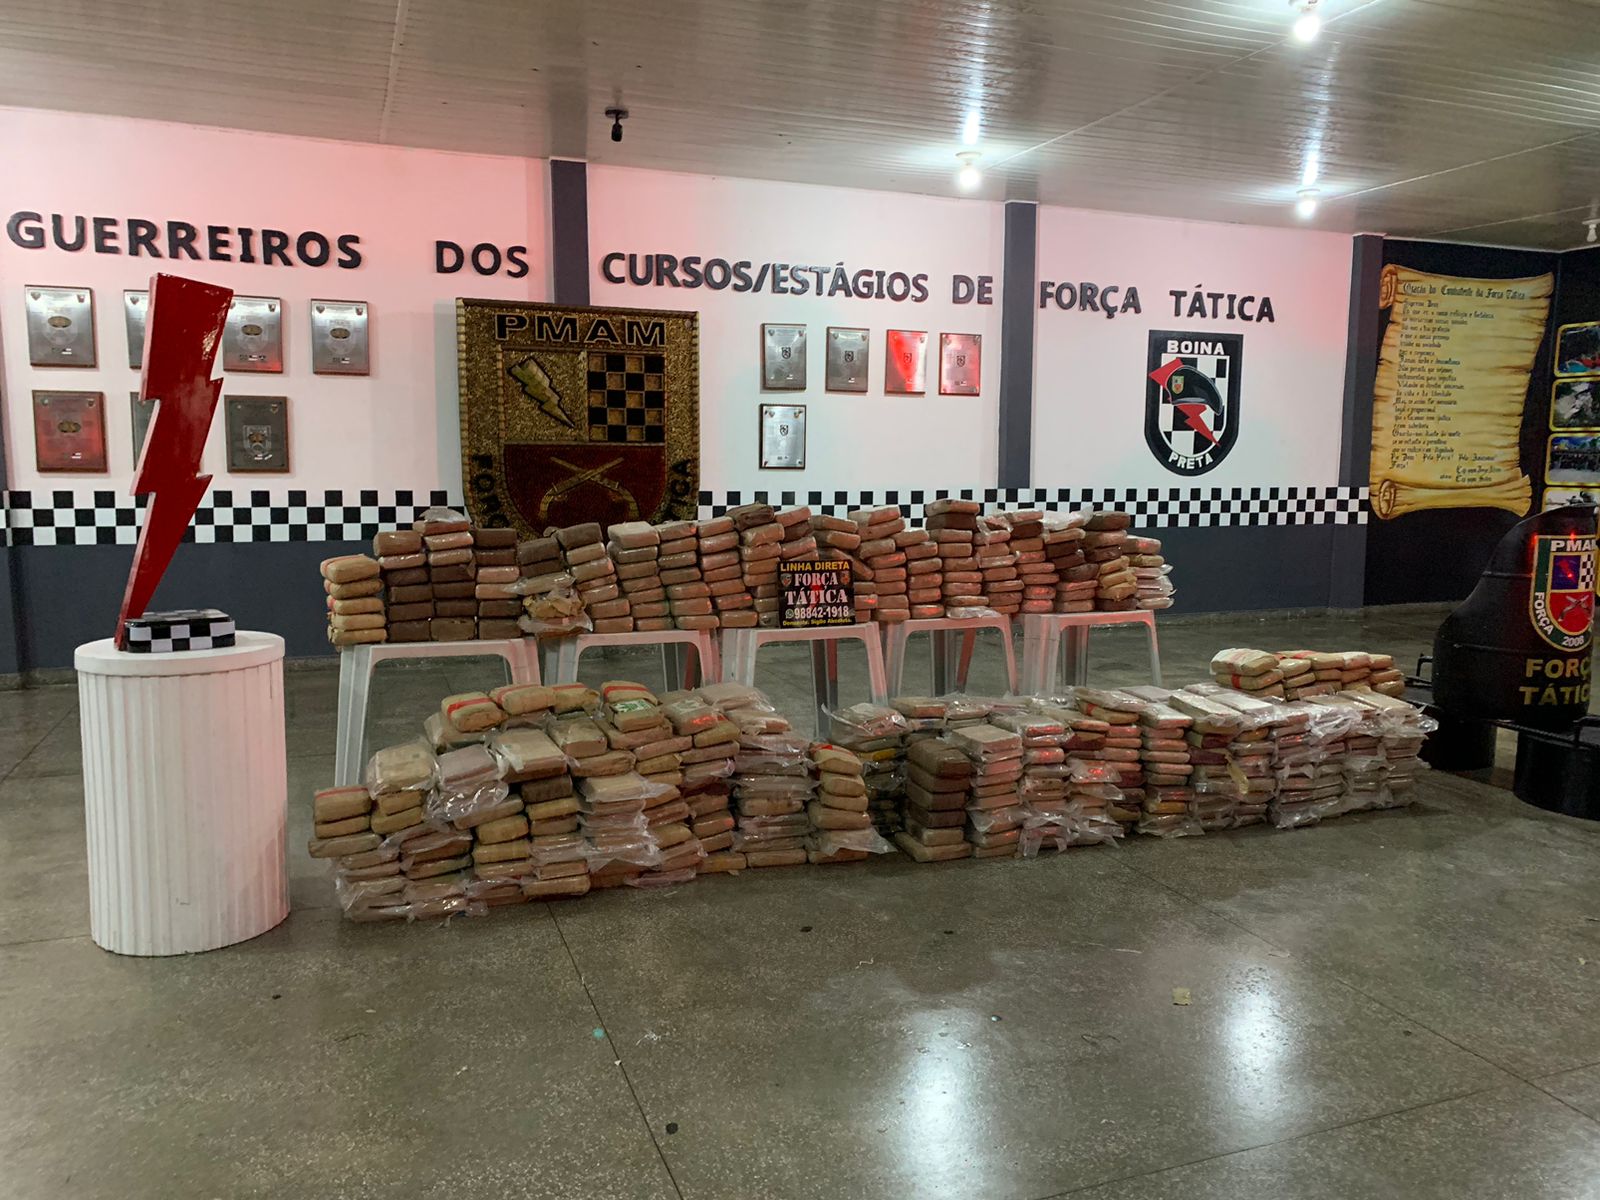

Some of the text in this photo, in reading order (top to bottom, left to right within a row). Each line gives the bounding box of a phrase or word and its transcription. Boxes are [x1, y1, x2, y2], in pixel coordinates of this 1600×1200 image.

[6, 211, 1275, 322] GUERREIROS DOS CURSOS/ESTÁGIOS DE FORÇA TÁTICA
[494, 313, 666, 346] PMAM
[1167, 339, 1225, 355] BOINA
[1168, 453, 1213, 469] PRETA
[780, 561, 850, 572] LINHA DIRETA
[794, 572, 838, 589] FORÇA
[785, 587, 848, 605] TÁTICA
[794, 606, 849, 619] 98842-1918
[1534, 591, 1554, 635] FORÇA
